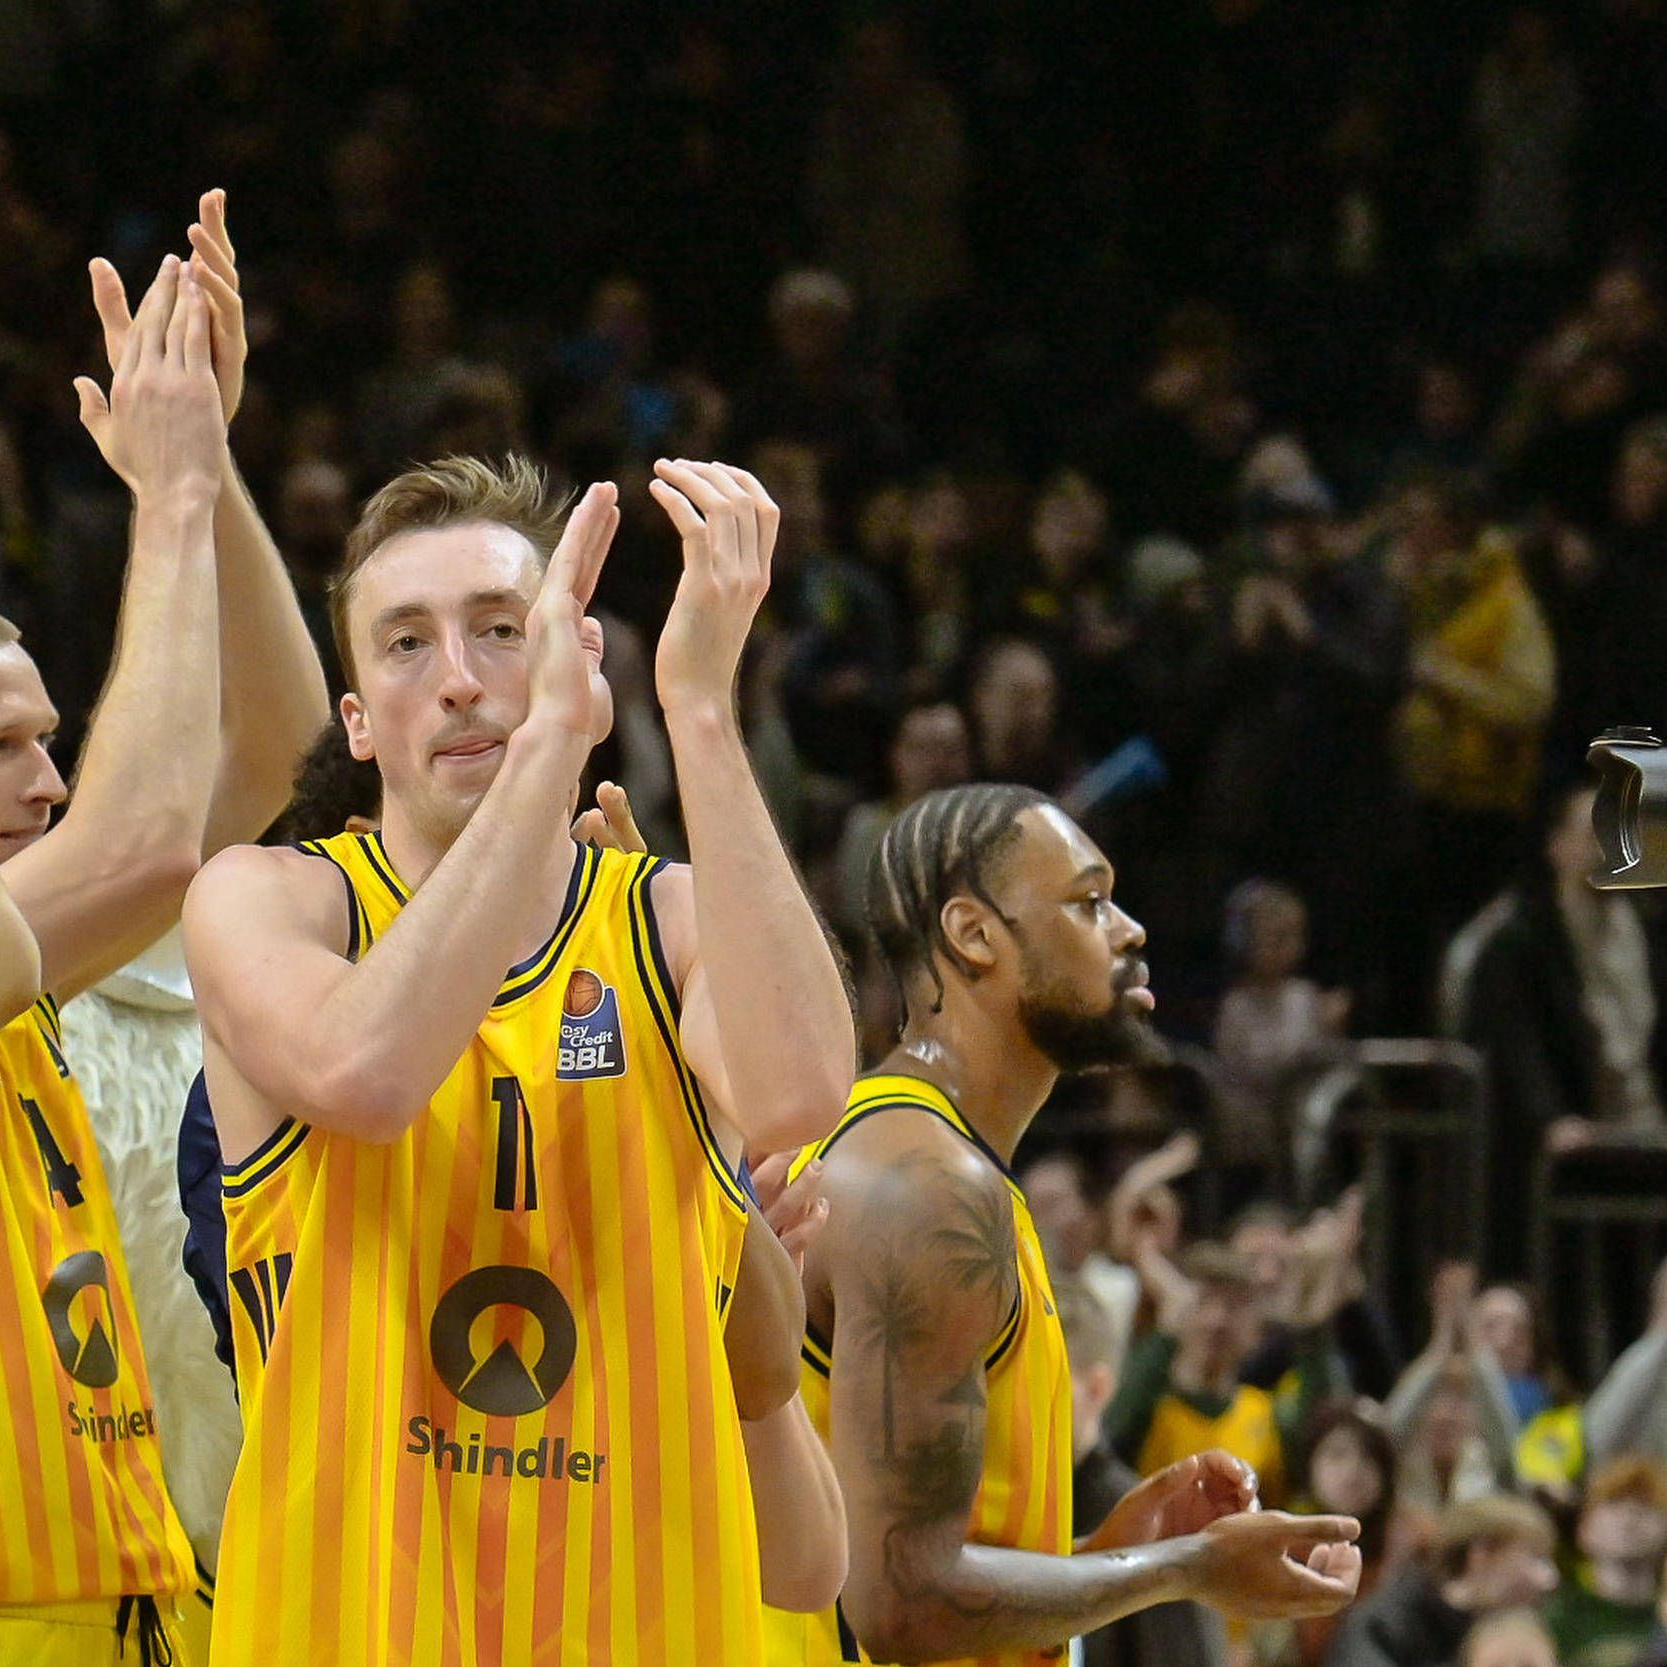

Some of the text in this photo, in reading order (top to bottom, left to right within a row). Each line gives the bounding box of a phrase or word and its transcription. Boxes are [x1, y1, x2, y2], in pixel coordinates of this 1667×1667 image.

[569, 1030, 613, 1048] Credit
[557, 1046, 616, 1072] BBL
[406, 1415, 606, 1484] Shindler
